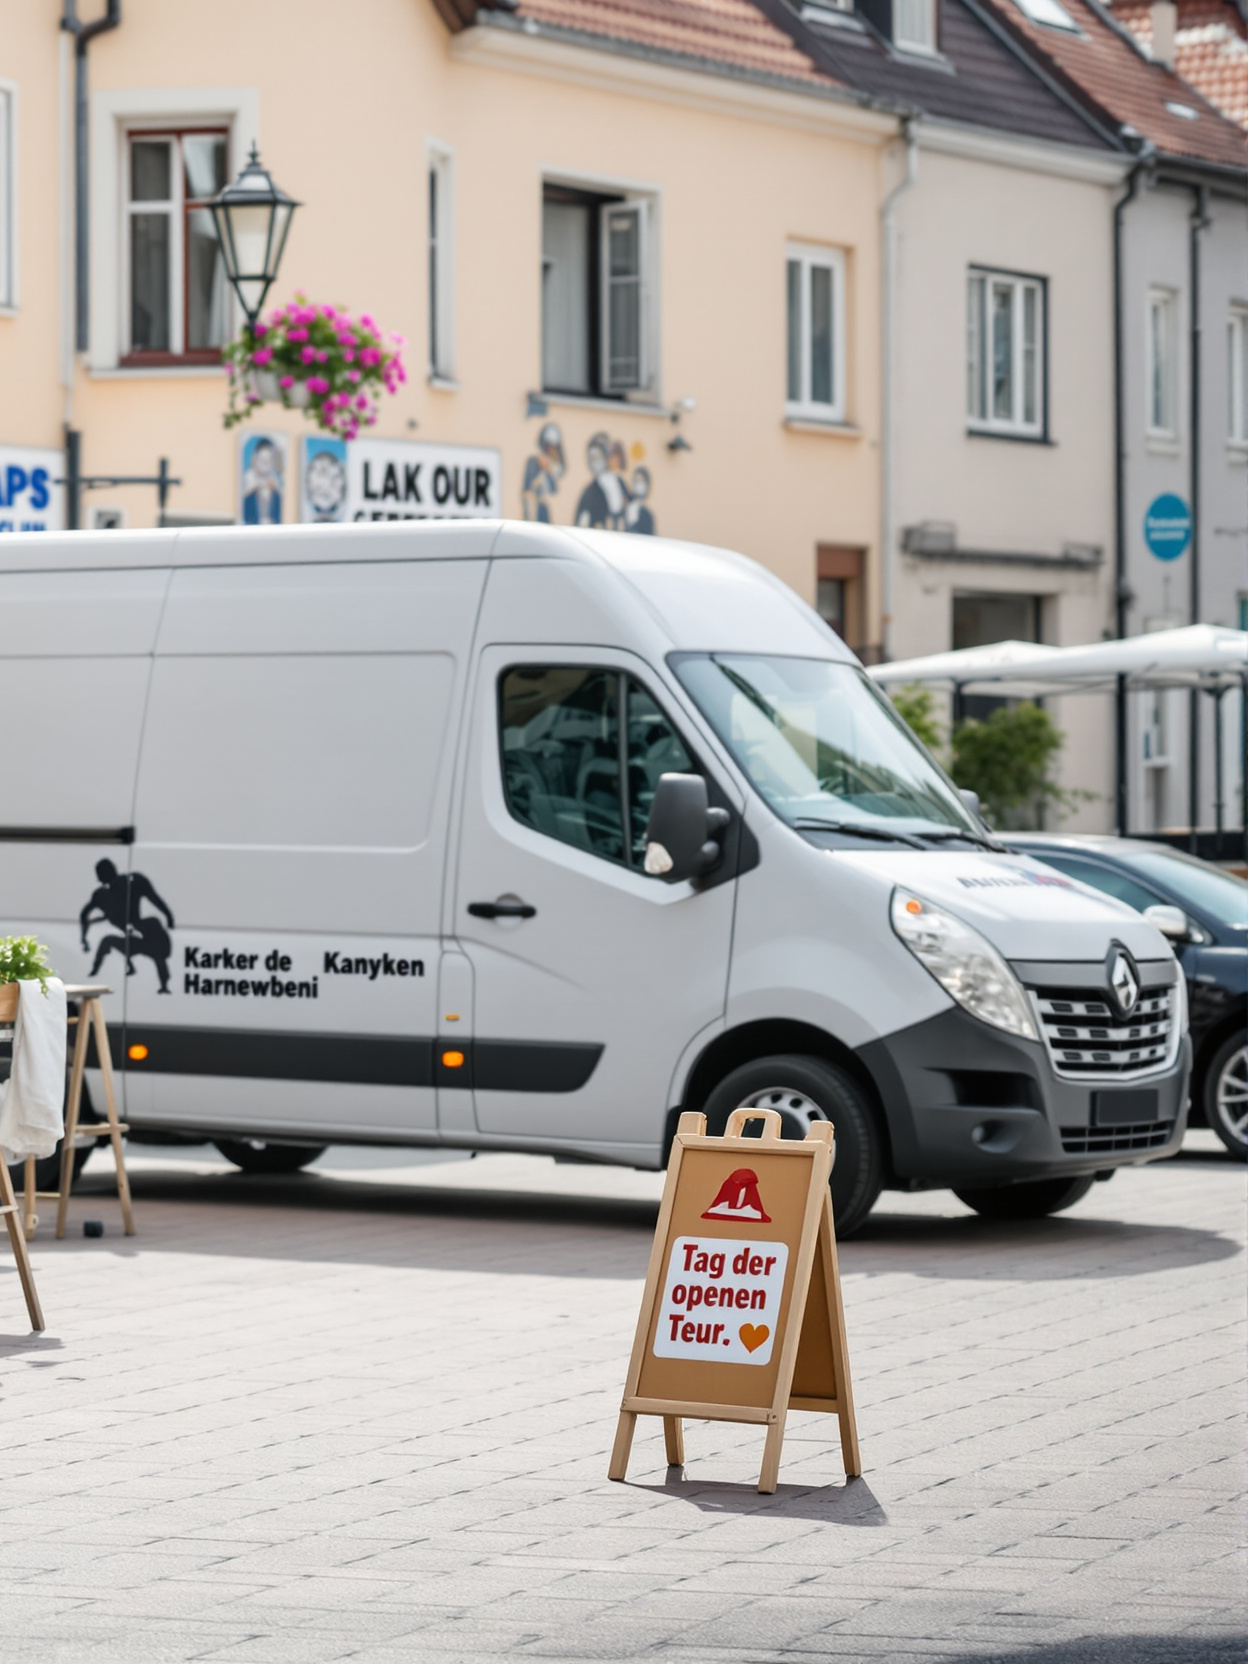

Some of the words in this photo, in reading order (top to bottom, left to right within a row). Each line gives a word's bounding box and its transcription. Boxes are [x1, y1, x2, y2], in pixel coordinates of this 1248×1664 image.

[363, 461, 422, 503] LAK
[432, 463, 491, 507] OUR
[184, 947, 259, 970] Karker
[265, 949, 292, 972] de
[323, 951, 425, 981] Kanyken
[184, 973, 319, 999] Harnewbeni
[683, 1243, 726, 1280] Tag
[732, 1247, 777, 1277] der
[671, 1283, 767, 1312] openen
[669, 1313, 731, 1347] Teur.
